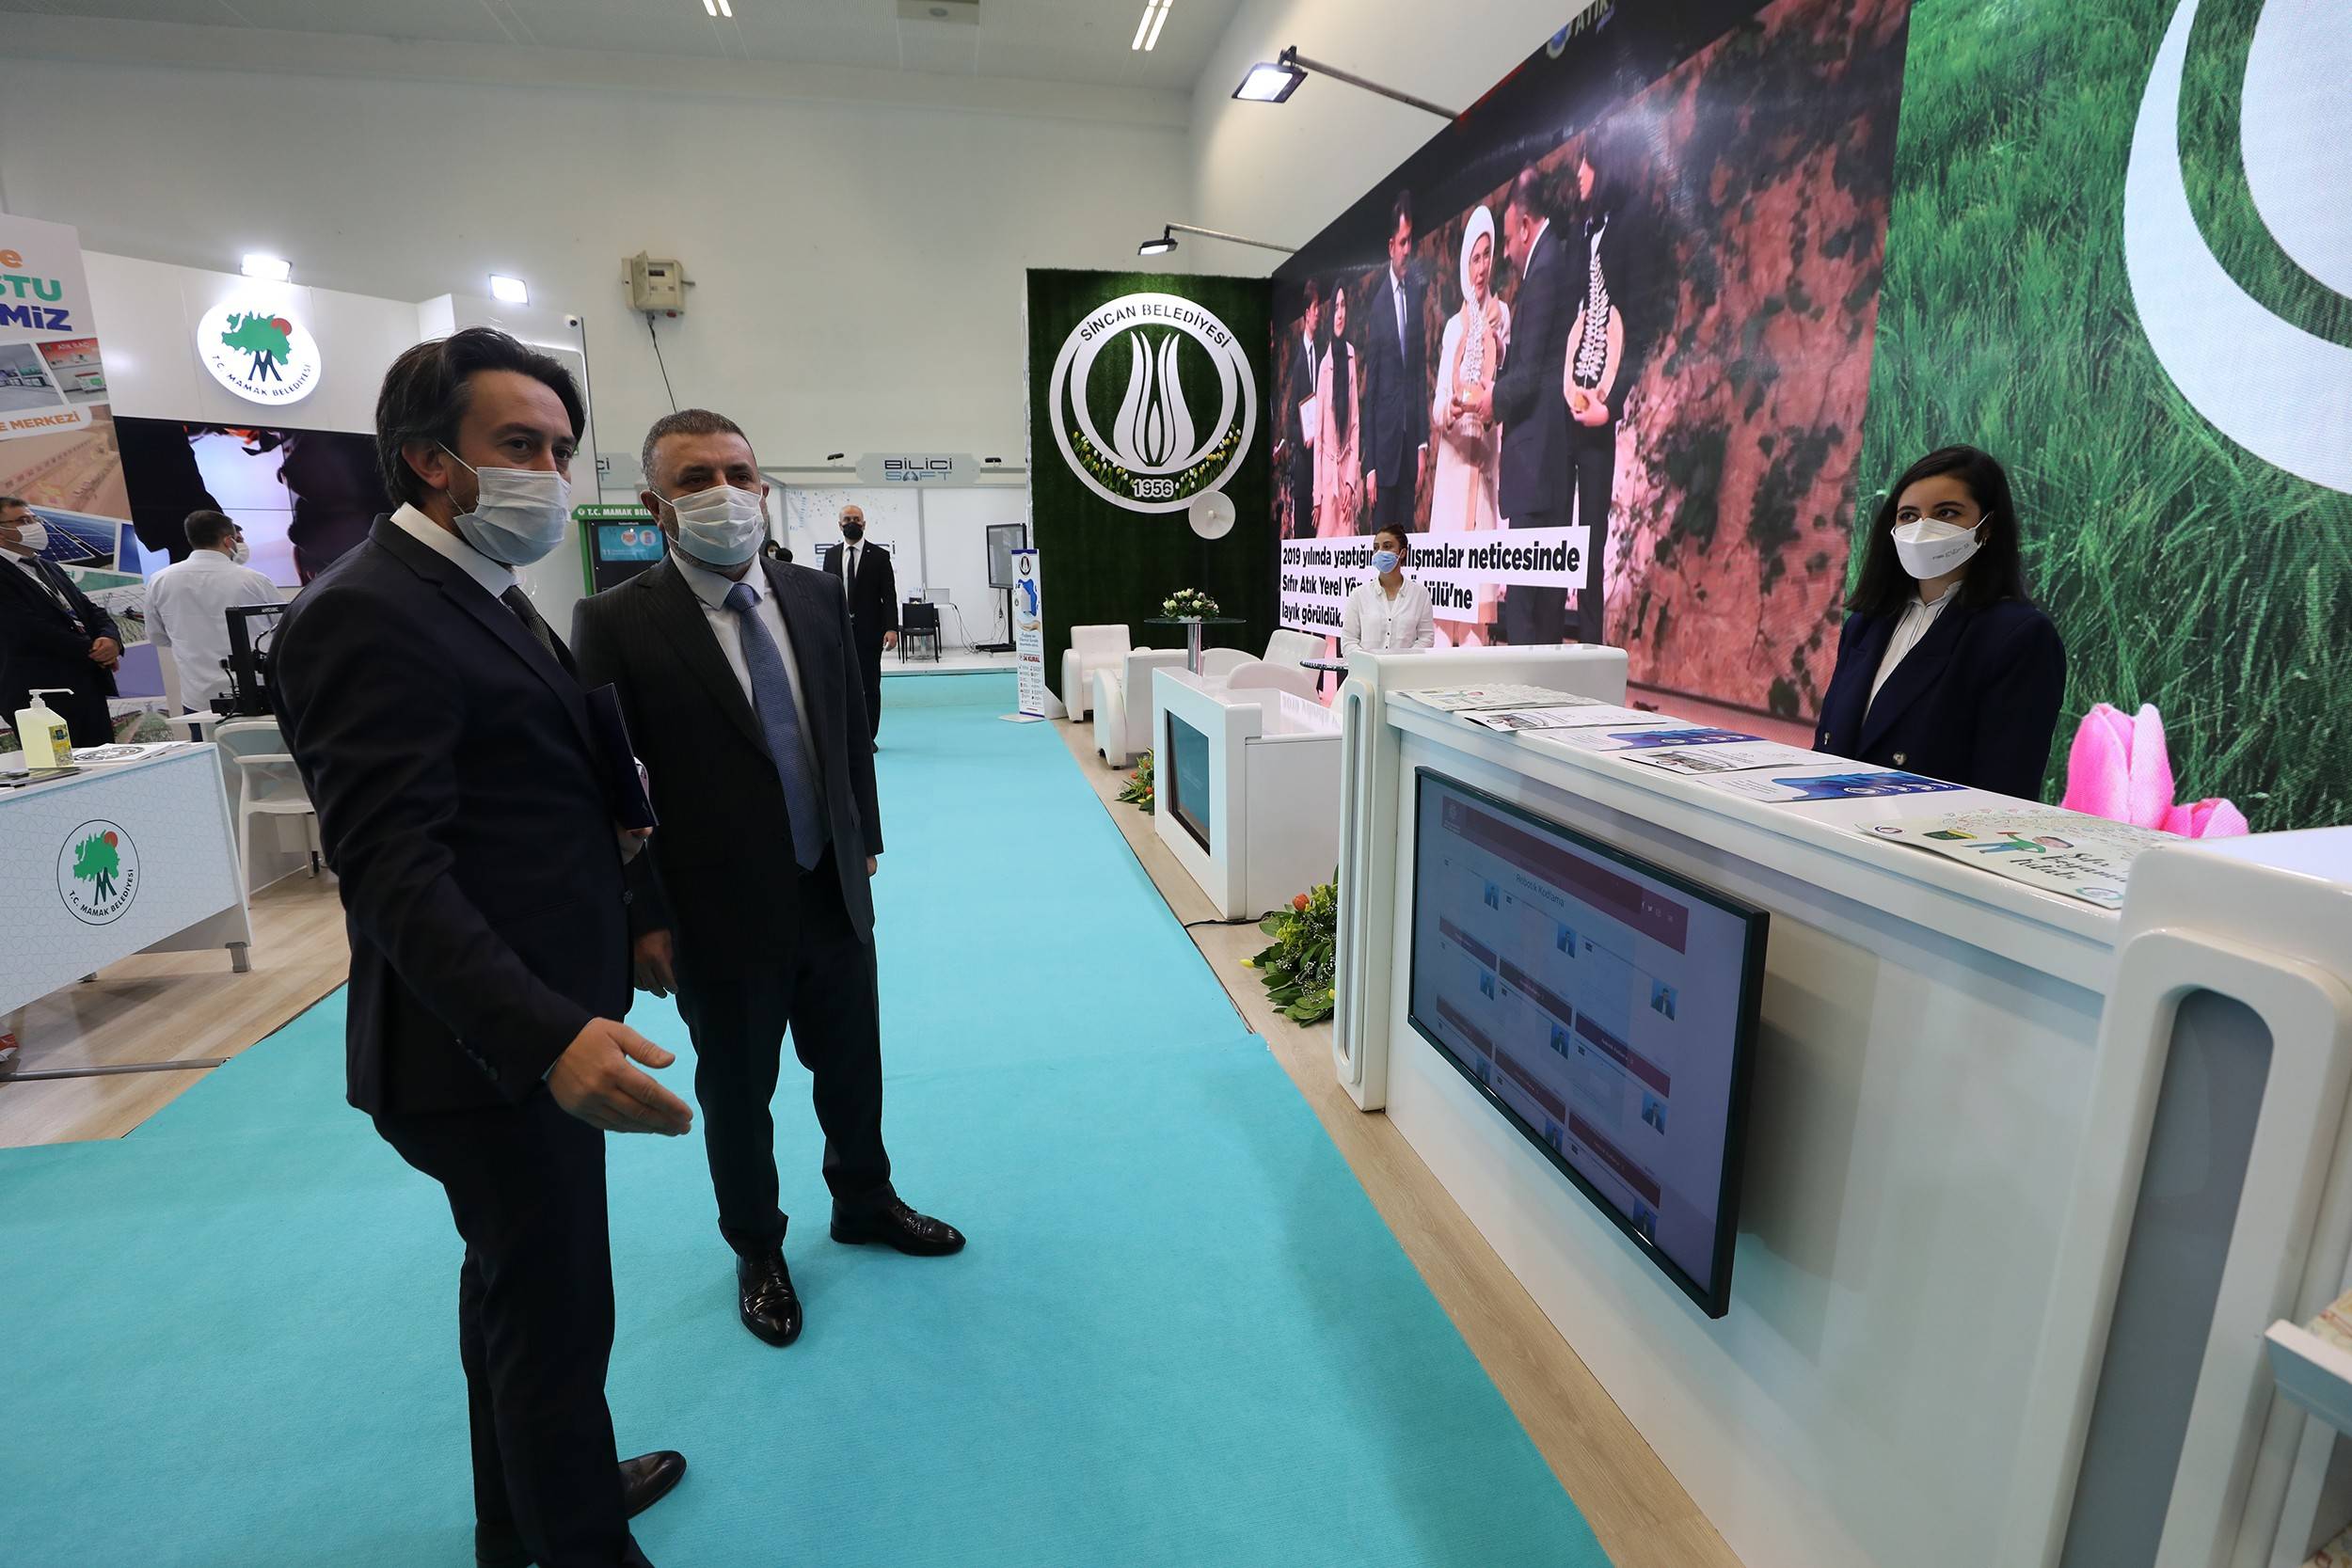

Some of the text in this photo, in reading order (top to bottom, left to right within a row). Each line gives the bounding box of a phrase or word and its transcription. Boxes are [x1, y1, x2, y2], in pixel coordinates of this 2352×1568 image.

[1081, 304, 1232, 349] SİNCAN BELEDİYESİ
[228, 373, 268, 396] MAMAK
[9, 411, 81, 431] MERKEZİ
[1134, 481, 1173, 497] 1956
[587, 508, 600, 516] T.C.
[603, 508, 632, 516] MAMAK
[1282, 546, 1300, 565] 2019
[1302, 546, 1331, 569] yılında
[1404, 542, 1464, 572] lışmalar
[1469, 540, 1581, 573] neticesinde
[1282, 575, 1298, 593] Sıfır
[1300, 576, 1317, 594] Atık
[1319, 576, 1342, 597] Yerel
[1282, 600, 1343, 628] layık görüldük.
[69, 868, 135, 917] T.C. MAMAK BELEDİYESİ
